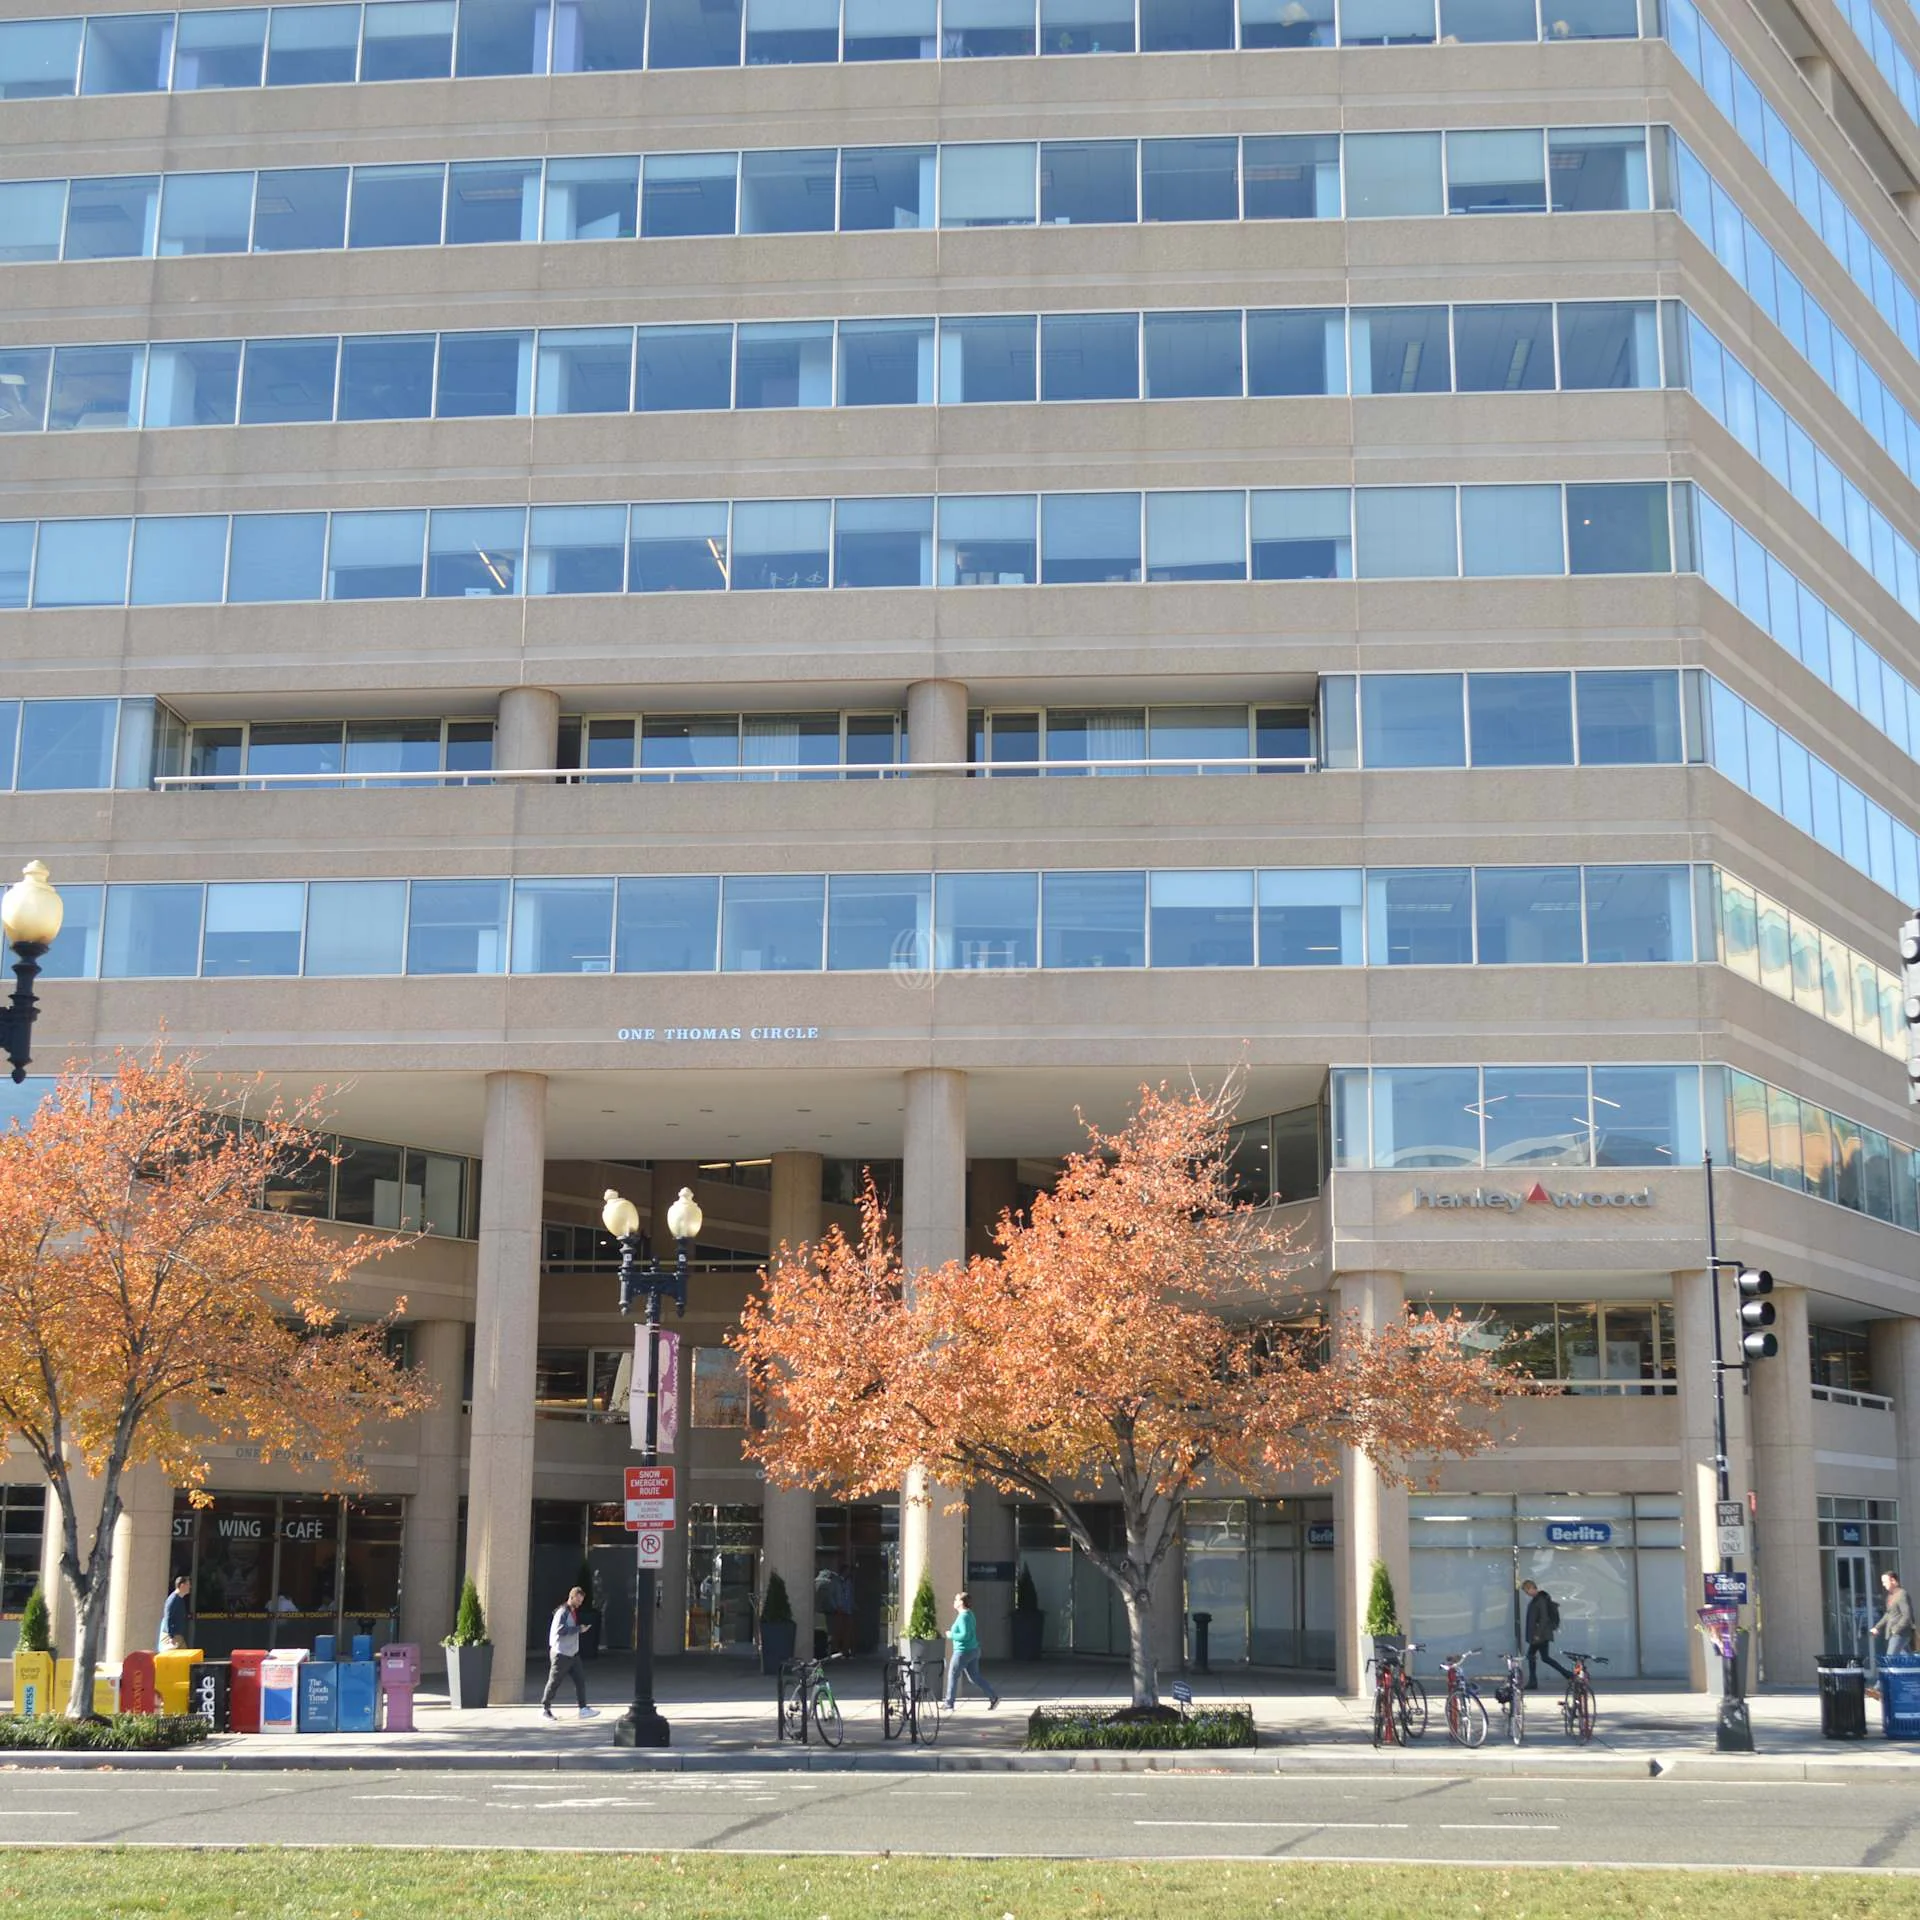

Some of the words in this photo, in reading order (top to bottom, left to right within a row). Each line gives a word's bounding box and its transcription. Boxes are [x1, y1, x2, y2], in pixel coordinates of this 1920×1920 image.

[617, 1028, 656, 1041] ONE
[664, 1027, 742, 1040] THOMAS
[750, 1026, 819, 1040] CIRCLE
[1413, 1187, 1525, 1214] hanley
[1550, 1186, 1657, 1209] wood
[639, 1470, 661, 1479] SNOW
[630, 1478, 669, 1488] EMERGENCY
[639, 1487, 661, 1496] ROUTE
[1718, 1504, 1741, 1515] RIGHT
[1719, 1515, 1741, 1526] LANE
[218, 1519, 262, 1538] WING
[286, 1519, 324, 1539] CAFÉ
[1551, 1526, 1605, 1541] Berlitz
[308, 1678, 322, 1686] The
[308, 1693, 329, 1702] Times
